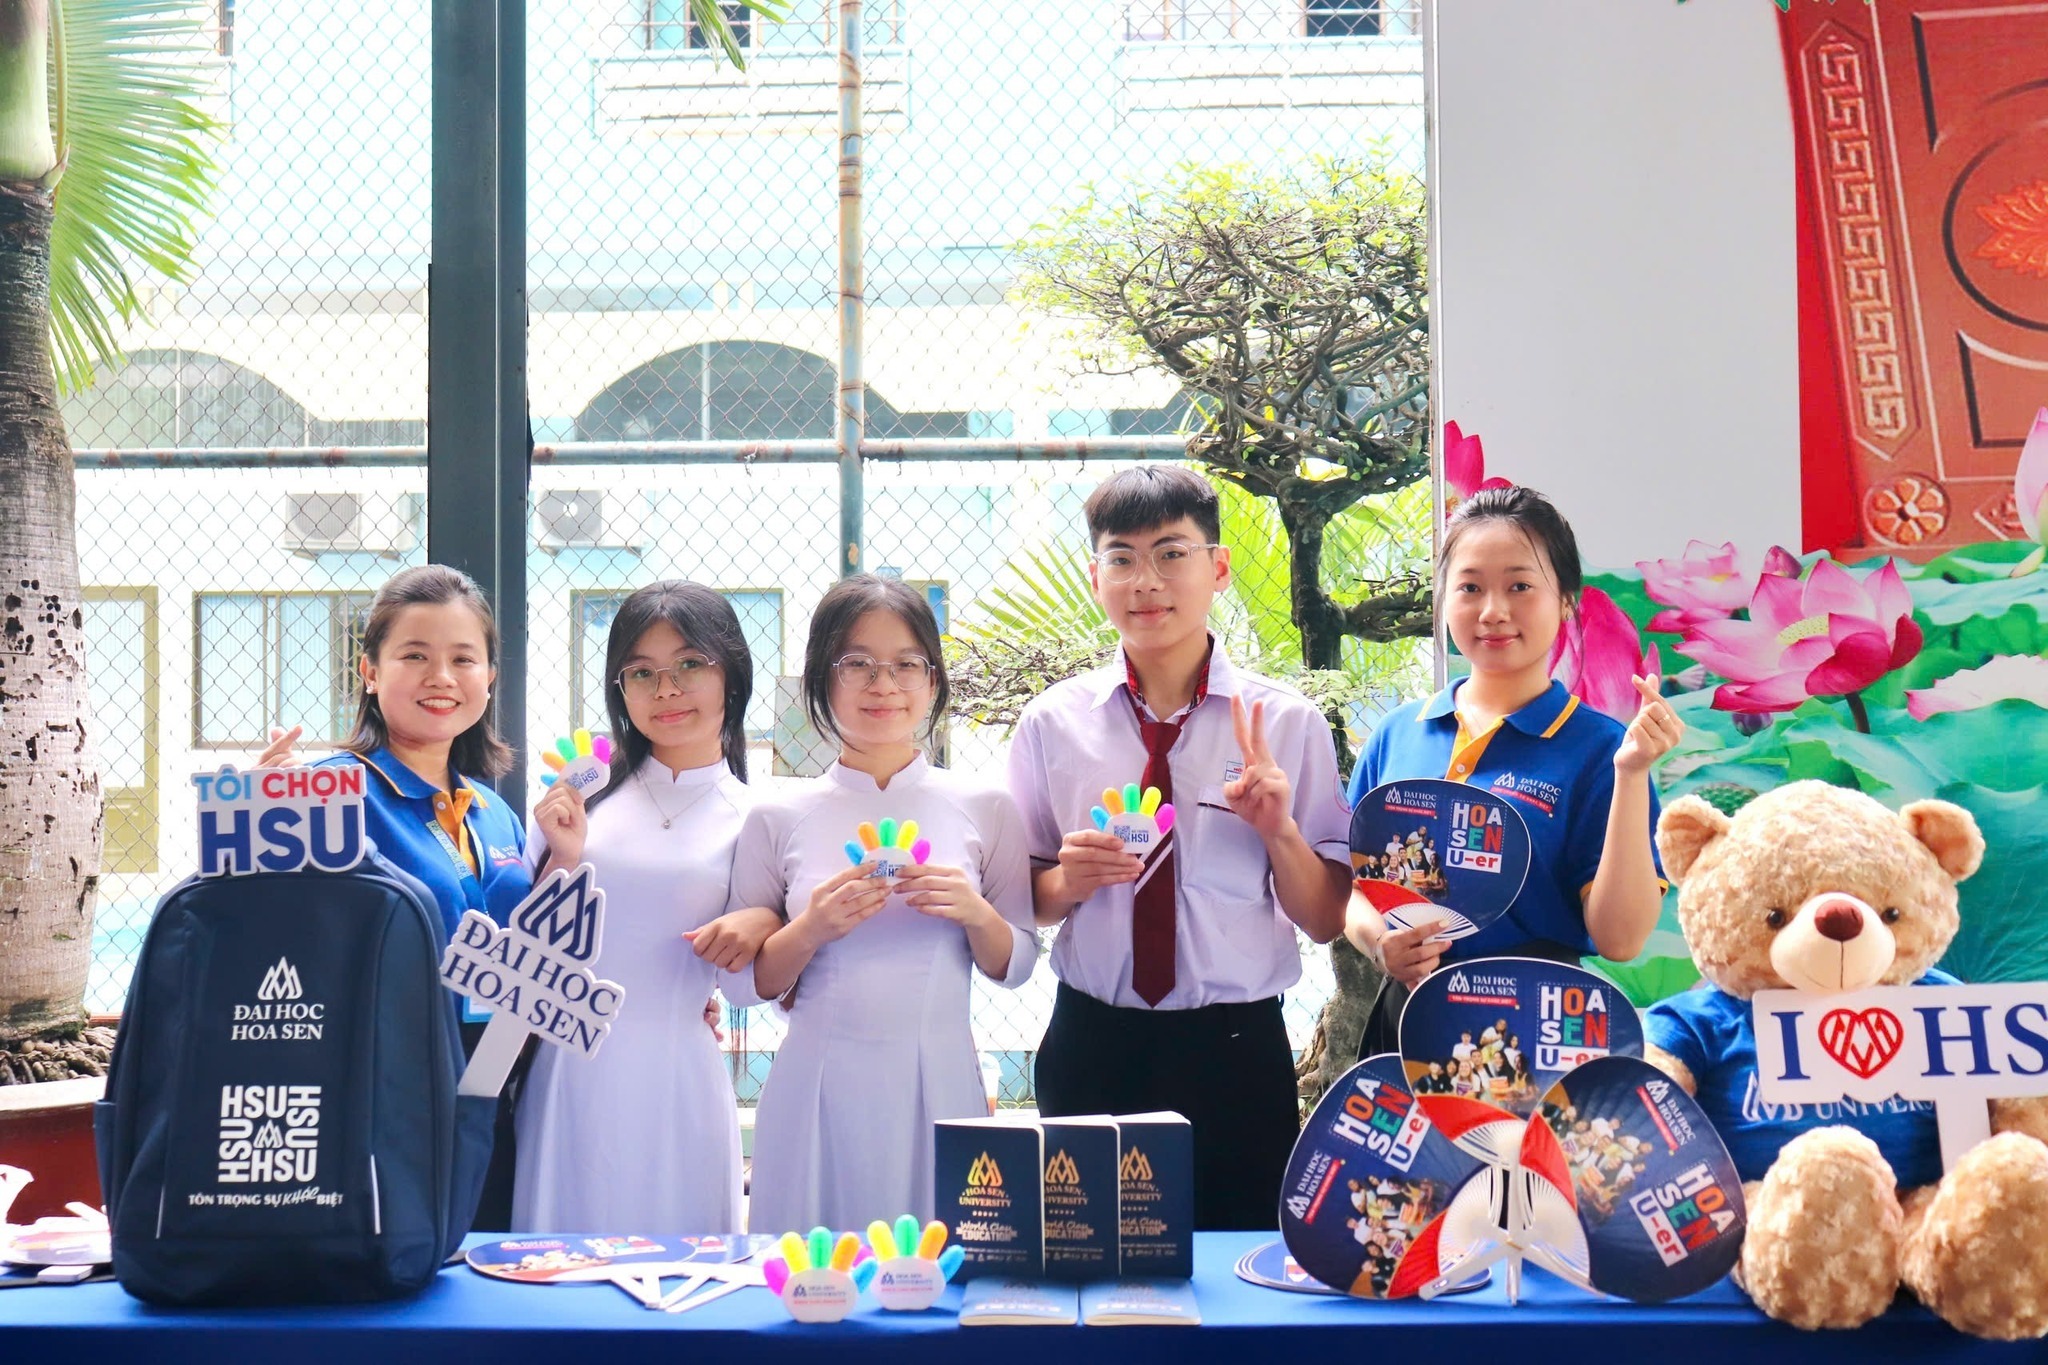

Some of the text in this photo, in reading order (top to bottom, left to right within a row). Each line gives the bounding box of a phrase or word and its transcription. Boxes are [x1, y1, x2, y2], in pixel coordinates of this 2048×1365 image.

[194, 768, 361, 804] TÔI CHỌN
[581, 770, 599, 785] HSU
[1516, 783, 1537, 796] HOA
[1538, 790, 1558, 805] SEN
[1452, 802, 1503, 830] HOA
[201, 804, 360, 873] HSU
[1131, 833, 1149, 843] HSU
[1450, 825, 1503, 852] SEN
[1449, 849, 1499, 868] U-er
[461, 917, 618, 1017] ĐẠI HỌC
[442, 952, 602, 1053] HOA SEN
[1472, 985, 1517, 996] HOA SEN
[1540, 985, 1607, 1021] HOA
[230, 1023, 324, 1041] HOA SEN
[1540, 1012, 1608, 1048] SEN
[1770, 1003, 2048, 1081] I HS
[220, 1085, 288, 1119] HSU
[284, 1086, 322, 1148] HSU
[1333, 1078, 1381, 1146] HOA
[1367, 1084, 1413, 1156] SEN
[218, 1118, 254, 1183] HSU
[250, 1149, 318, 1183] HSU
[965, 1186, 1006, 1198] HOA SEN
[1045, 1184, 1062, 1194] OA
[1045, 1195, 1089, 1206] IVERSITY
[1120, 1182, 1136, 1190] OA
[1121, 1192, 1162, 1202] IVERSITY
[1675, 1163, 1736, 1234] HOA
[959, 1196, 1013, 1208] UNIVERSITY
[1656, 1182, 1718, 1250] SEN
[1045, 1229, 1089, 1240] DUCATION
[1120, 1225, 1161, 1236] UCATION
[1636, 1195, 1681, 1256] U-er
